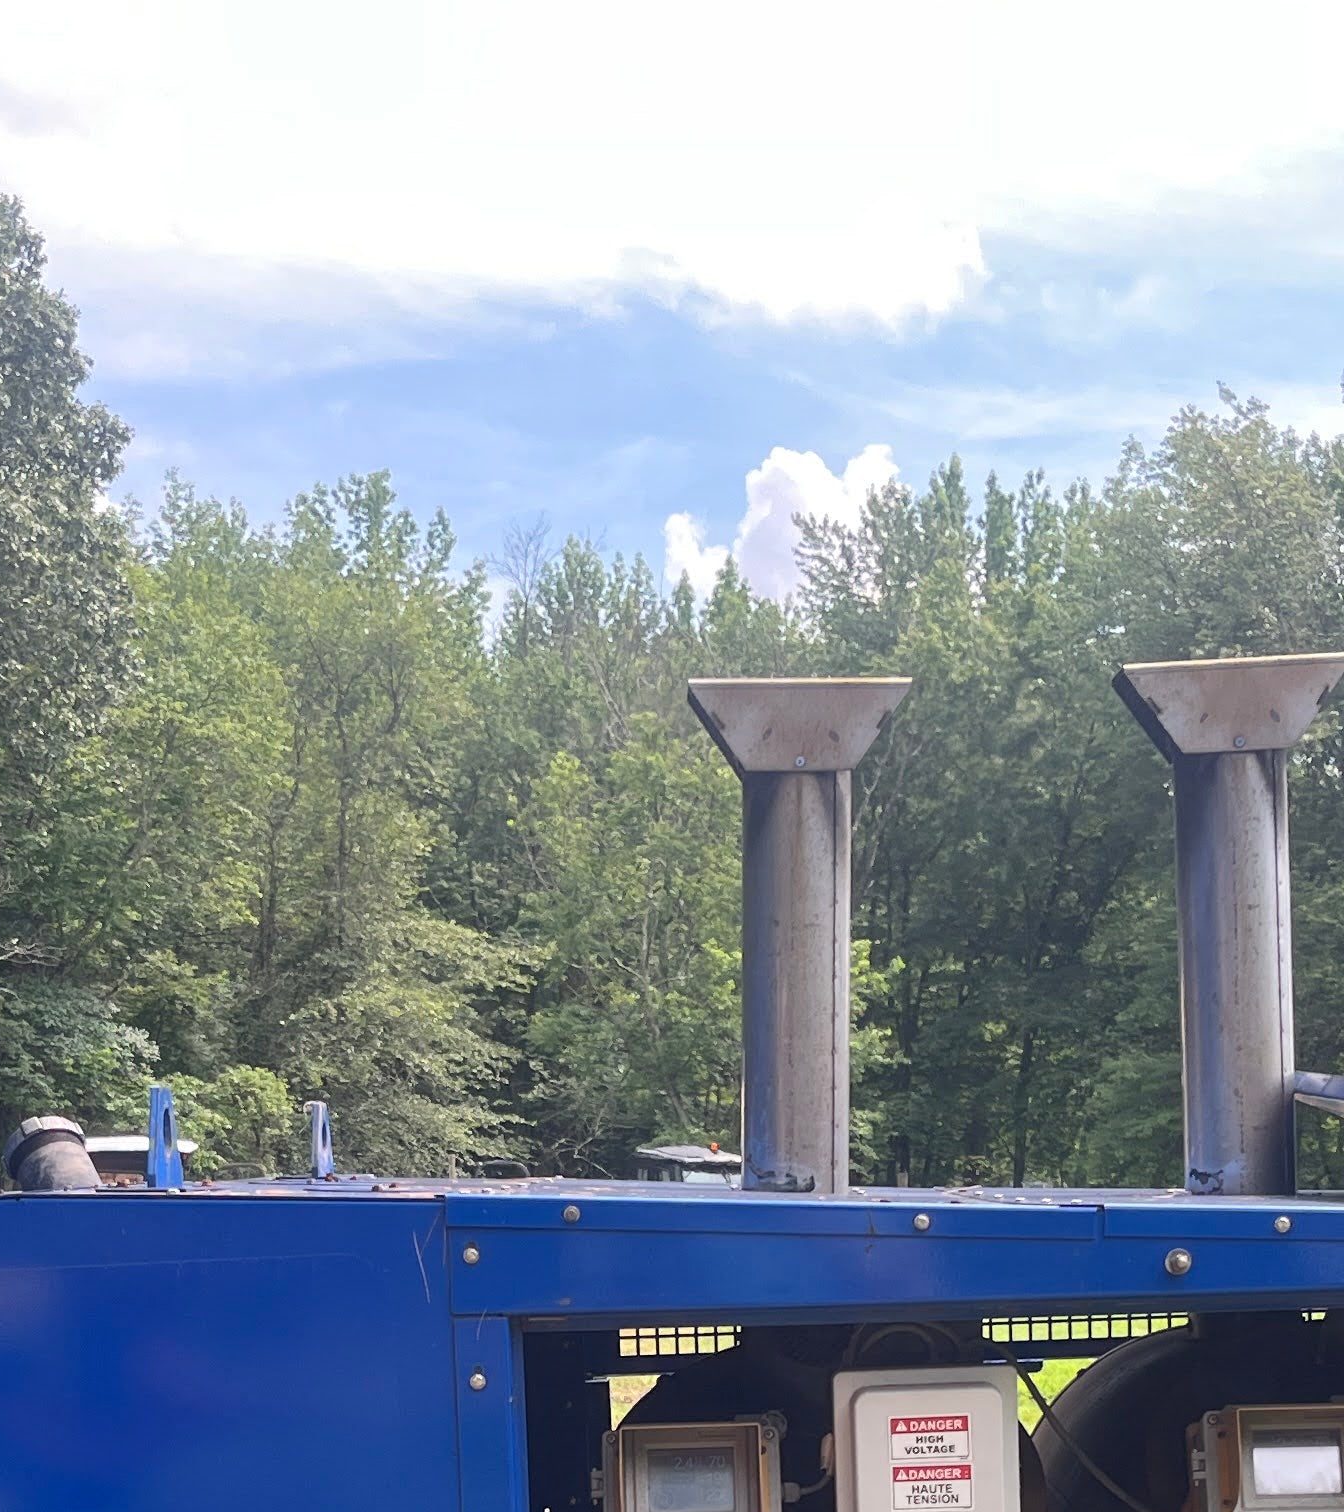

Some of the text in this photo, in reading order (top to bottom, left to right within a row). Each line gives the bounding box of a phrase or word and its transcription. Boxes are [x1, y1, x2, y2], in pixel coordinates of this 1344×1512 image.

[909, 1419, 963, 1431] DANGER
[915, 1435, 944, 1444] HIGH
[904, 1445, 956, 1455] VOLTAGE
[911, 1483, 953, 1494] HAUTE
[906, 1494, 959, 1505] TENSION
